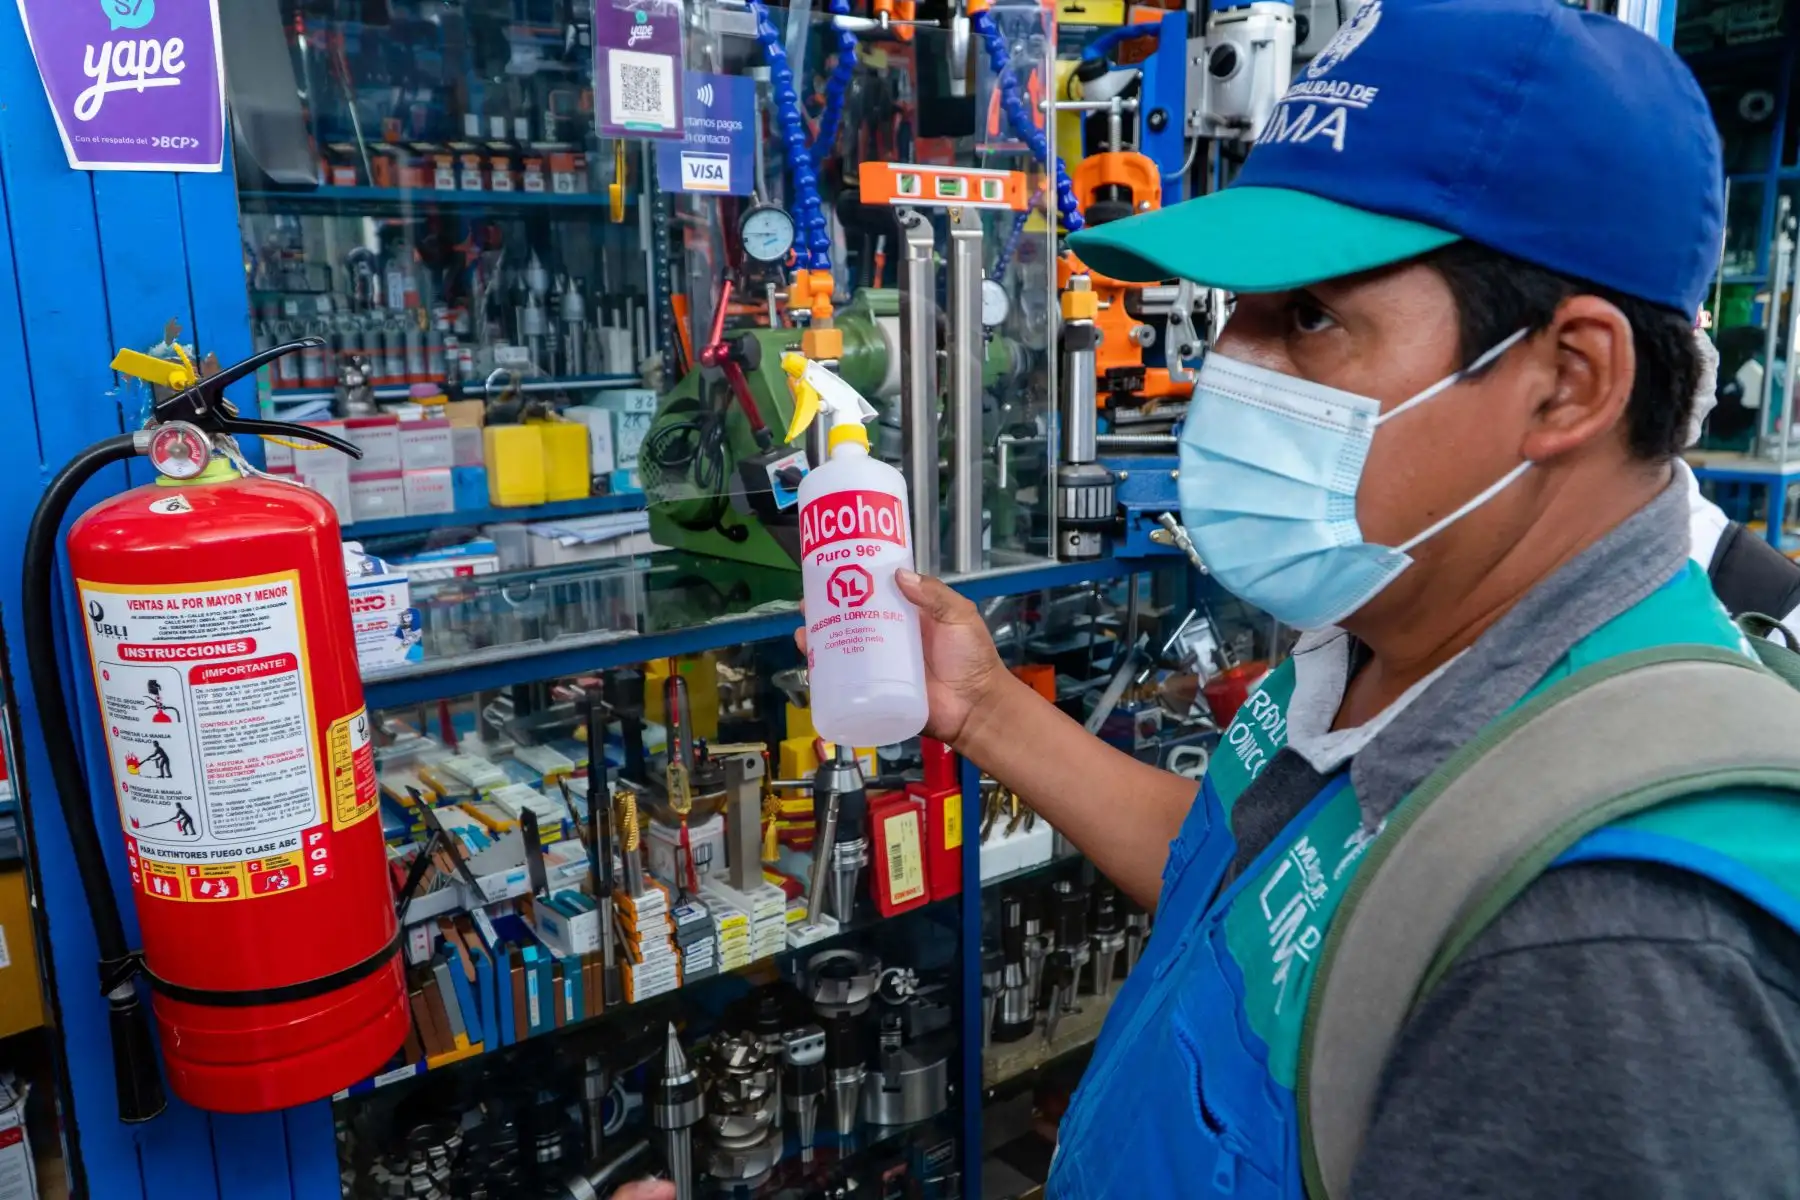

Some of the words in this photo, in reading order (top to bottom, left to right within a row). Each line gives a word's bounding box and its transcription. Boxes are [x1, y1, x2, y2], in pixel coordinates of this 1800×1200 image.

[628, 24, 654, 47] yape
[74, 37, 186, 121] yape
[1348, 83, 1379, 103] DE
[716, 119, 743, 132] pagos
[75, 135, 91, 143] Con
[92, 135, 100, 143] el
[101, 136, 135, 146] respaldo
[136, 137, 148, 145] del
[693, 133, 730, 144] contacto
[688, 163, 724, 180] VISA
[802, 494, 902, 556] Alcohol
[816, 548, 851, 566] Puro
[127, 600, 163, 611] VENTAS
[167, 599, 180, 610] AL
[182, 597, 204, 609] POR
[206, 592, 243, 608] MAYOR
[244, 591, 252, 602] Y
[255, 585, 288, 601] MENOR
[123, 641, 248, 659] INSTRUCCIONES
[824, 636, 863, 650] Contenido
[202, 657, 287, 680] ¡IMPORTANTE!
[308, 832, 323, 846] P
[127, 841, 136, 854] A
[140, 845, 156, 856] PARA
[157, 849, 208, 859] EXTINTORES
[210, 848, 243, 859] FUEGO
[245, 842, 276, 855] CLASE
[278, 838, 298, 849] ABC
[310, 847, 328, 861] Q
[129, 856, 137, 868] B
[250, 863, 259, 871] C
[189, 867, 197, 876] B
[312, 863, 327, 877] S
[132, 872, 140, 883] C
